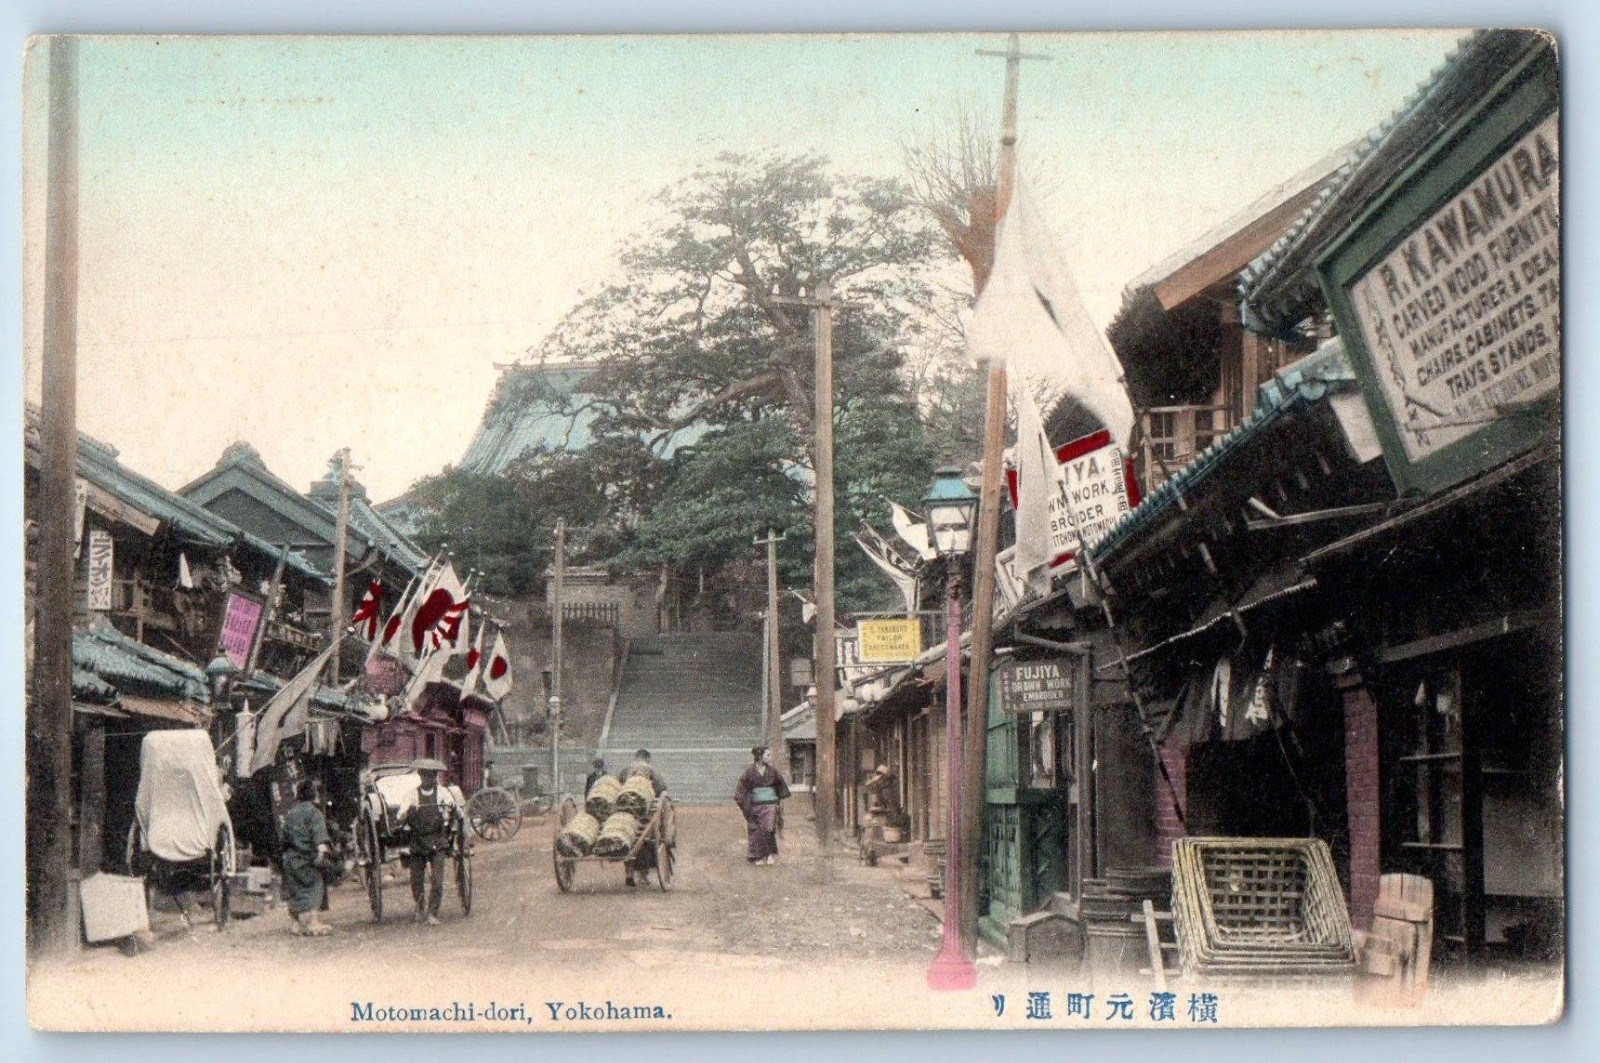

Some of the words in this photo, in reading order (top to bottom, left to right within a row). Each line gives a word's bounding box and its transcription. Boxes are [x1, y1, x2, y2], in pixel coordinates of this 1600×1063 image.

[1444, 252, 1488, 299] WOOD
[1072, 480, 1109, 503] WORK
[1016, 664, 1060, 680] FUJIYA
[1046, 678, 1072, 689] WORK
